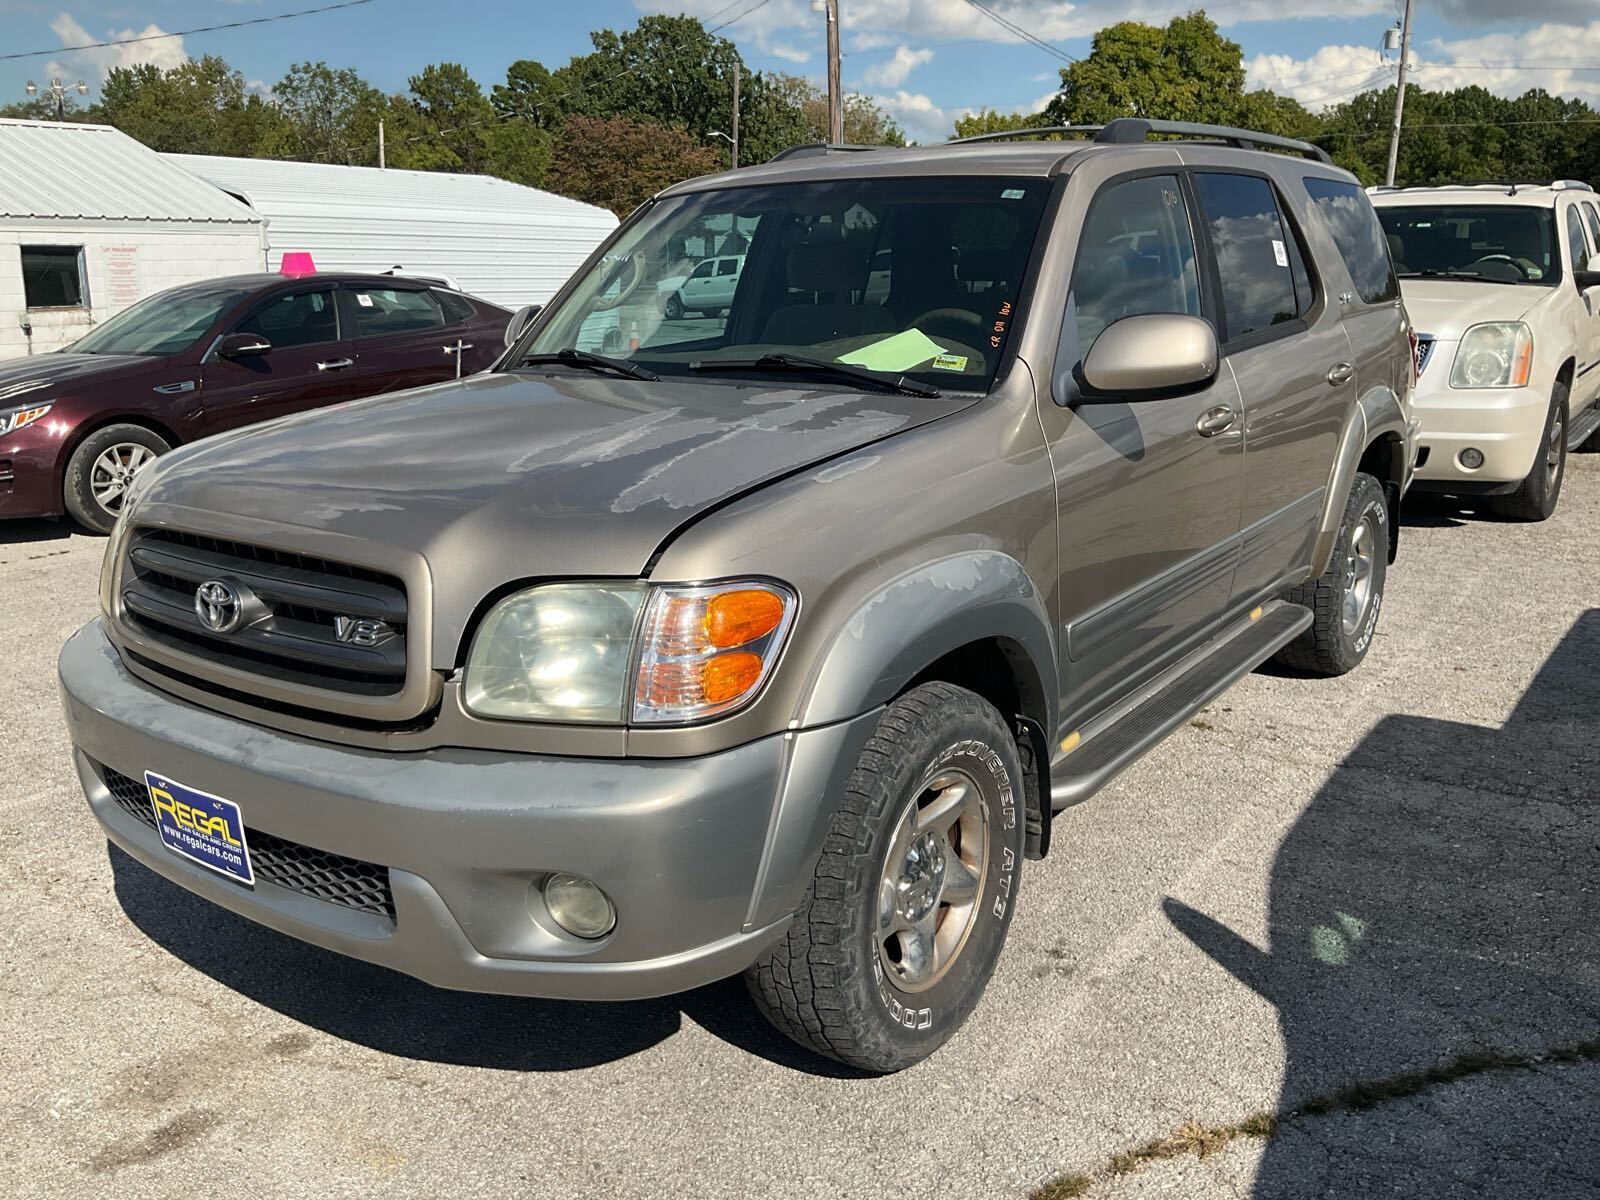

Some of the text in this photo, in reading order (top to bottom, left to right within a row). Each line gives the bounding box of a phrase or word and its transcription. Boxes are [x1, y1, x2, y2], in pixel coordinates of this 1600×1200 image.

[333, 616, 377, 646] V8
[151, 786, 241, 847] REGAL
[163, 824, 242, 866] www.regalcars.com
[210, 835, 222, 846] AND
